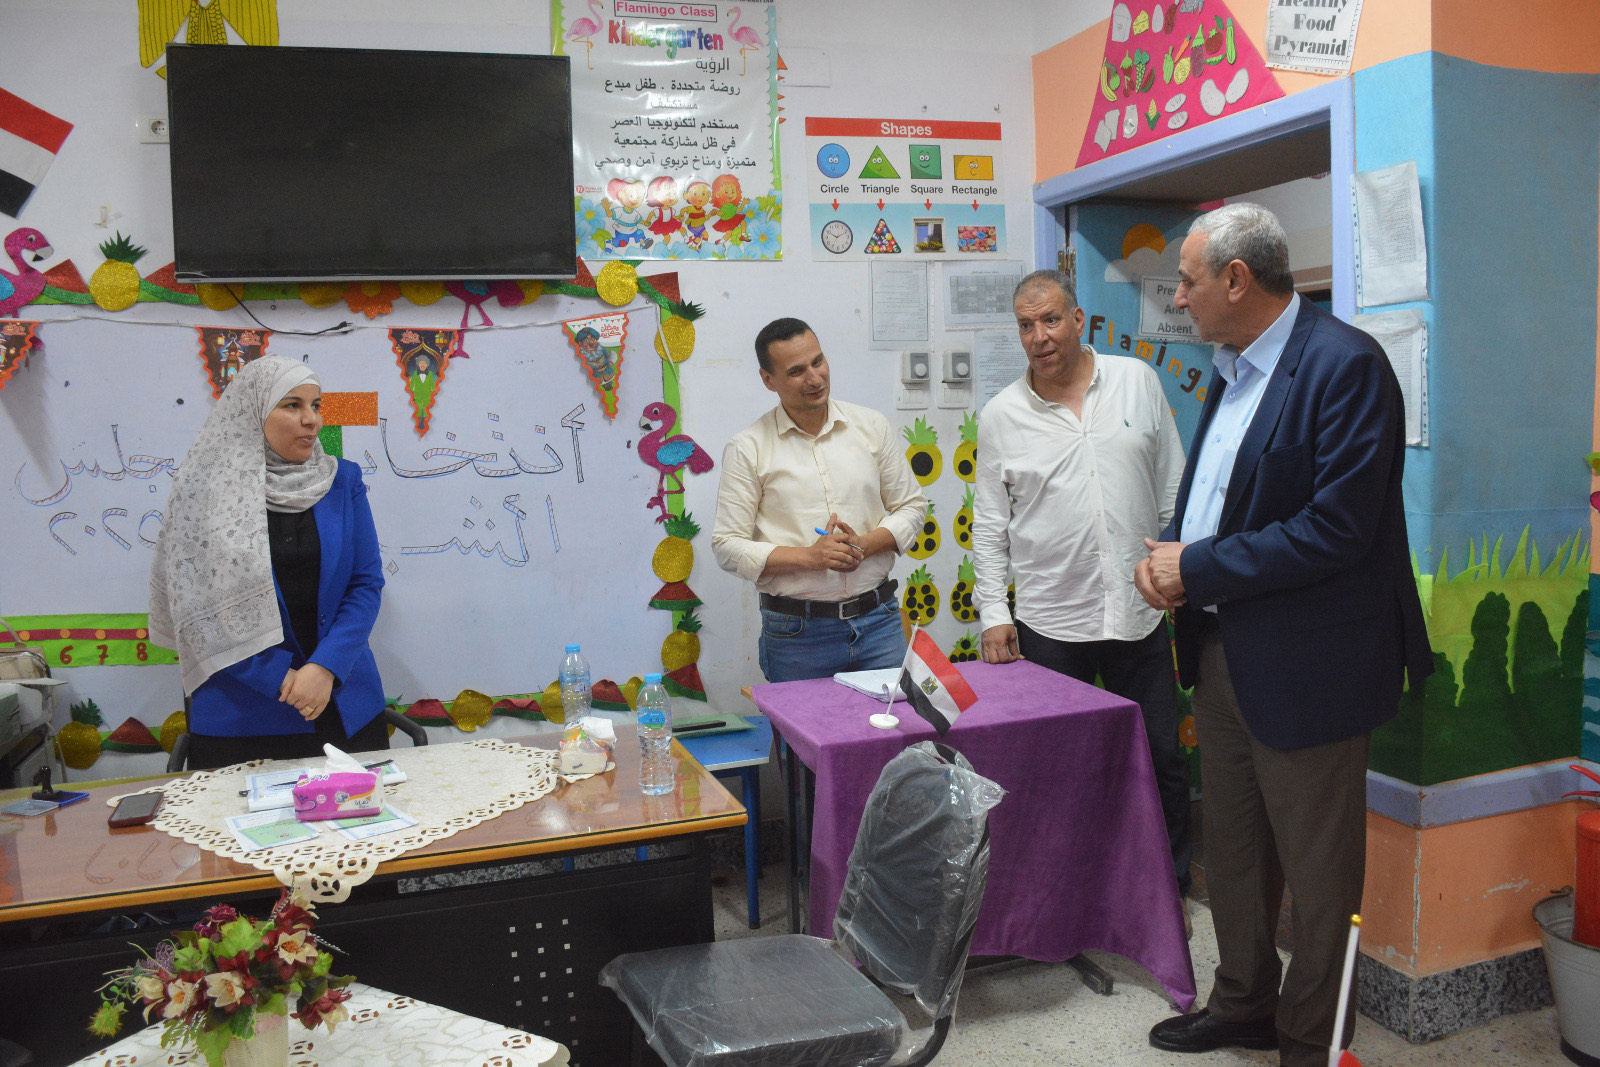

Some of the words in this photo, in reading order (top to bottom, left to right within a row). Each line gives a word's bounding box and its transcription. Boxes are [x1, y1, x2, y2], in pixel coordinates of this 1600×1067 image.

[616, 1, 676, 17] Flamingo
[680, 5, 715, 17] Class
[1293, 13, 1337, 31] Food
[608, 19, 724, 59] Kindergarten
[1273, 34, 1347, 56] Pyramid
[695, 57, 730, 74] الرؤية
[604, 78, 631, 93] مبدع
[635, 78, 657, 92] طفل
[671, 79, 706, 93] متجددة
[709, 79, 741, 96] روضة
[610, 115, 642, 129] العصر
[700, 118, 739, 133] مستخدم
[881, 121, 932, 138] Shapes
[614, 132, 657, 149] مجتمعية
[661, 133, 698, 150] مشاركة
[702, 135, 718, 150] ظل
[721, 136, 736, 154] في
[594, 156, 632, 171] وصحي
[635, 152, 655, 167] آمن
[660, 155, 688, 171] تربوي
[692, 155, 722, 171] ومناخ
[726, 155, 757, 169] متميزة
[820, 184, 849, 194] Circle
[861, 184, 900, 195] Triangle
[910, 184, 944, 196] Square
[951, 185, 998, 196] Rectangle
[1156, 284, 1177, 296] Pres
[1164, 304, 1185, 315] And
[1157, 322, 1193, 335] Absent
[1088, 315, 1208, 402] Flamingo
[59, 645, 74, 665] 6
[96, 644, 109, 665] 7
[136, 642, 148, 661] 8
